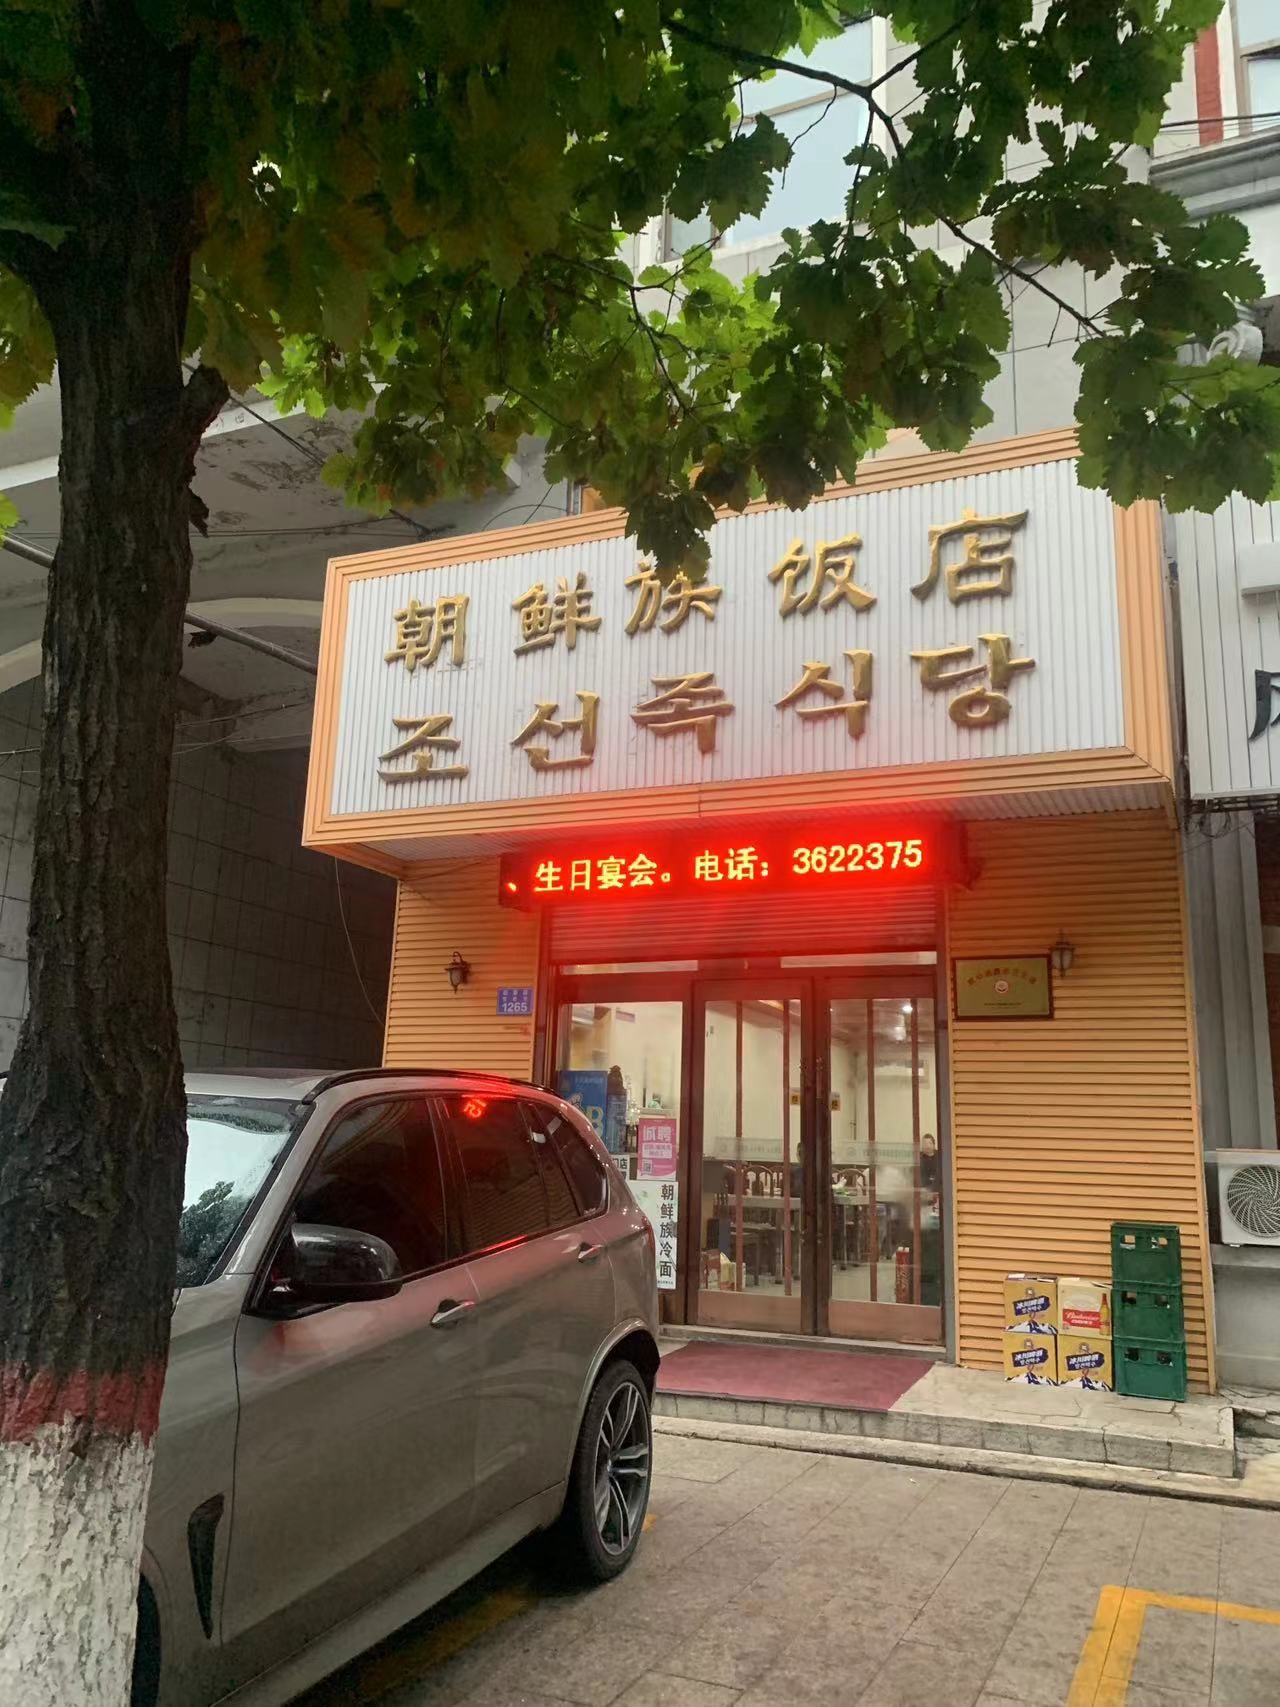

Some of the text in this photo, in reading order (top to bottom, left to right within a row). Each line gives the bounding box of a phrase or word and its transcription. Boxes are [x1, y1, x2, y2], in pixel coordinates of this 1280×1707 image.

[385, 508, 1028, 672] 朝鲜族饭店
[377, 632, 1036, 783] 조선족식당
[792, 839, 923, 875] 3622375
[502, 1002, 528, 1012] 1265
[659, 1184, 674, 1277] 朝鲜族冷面
